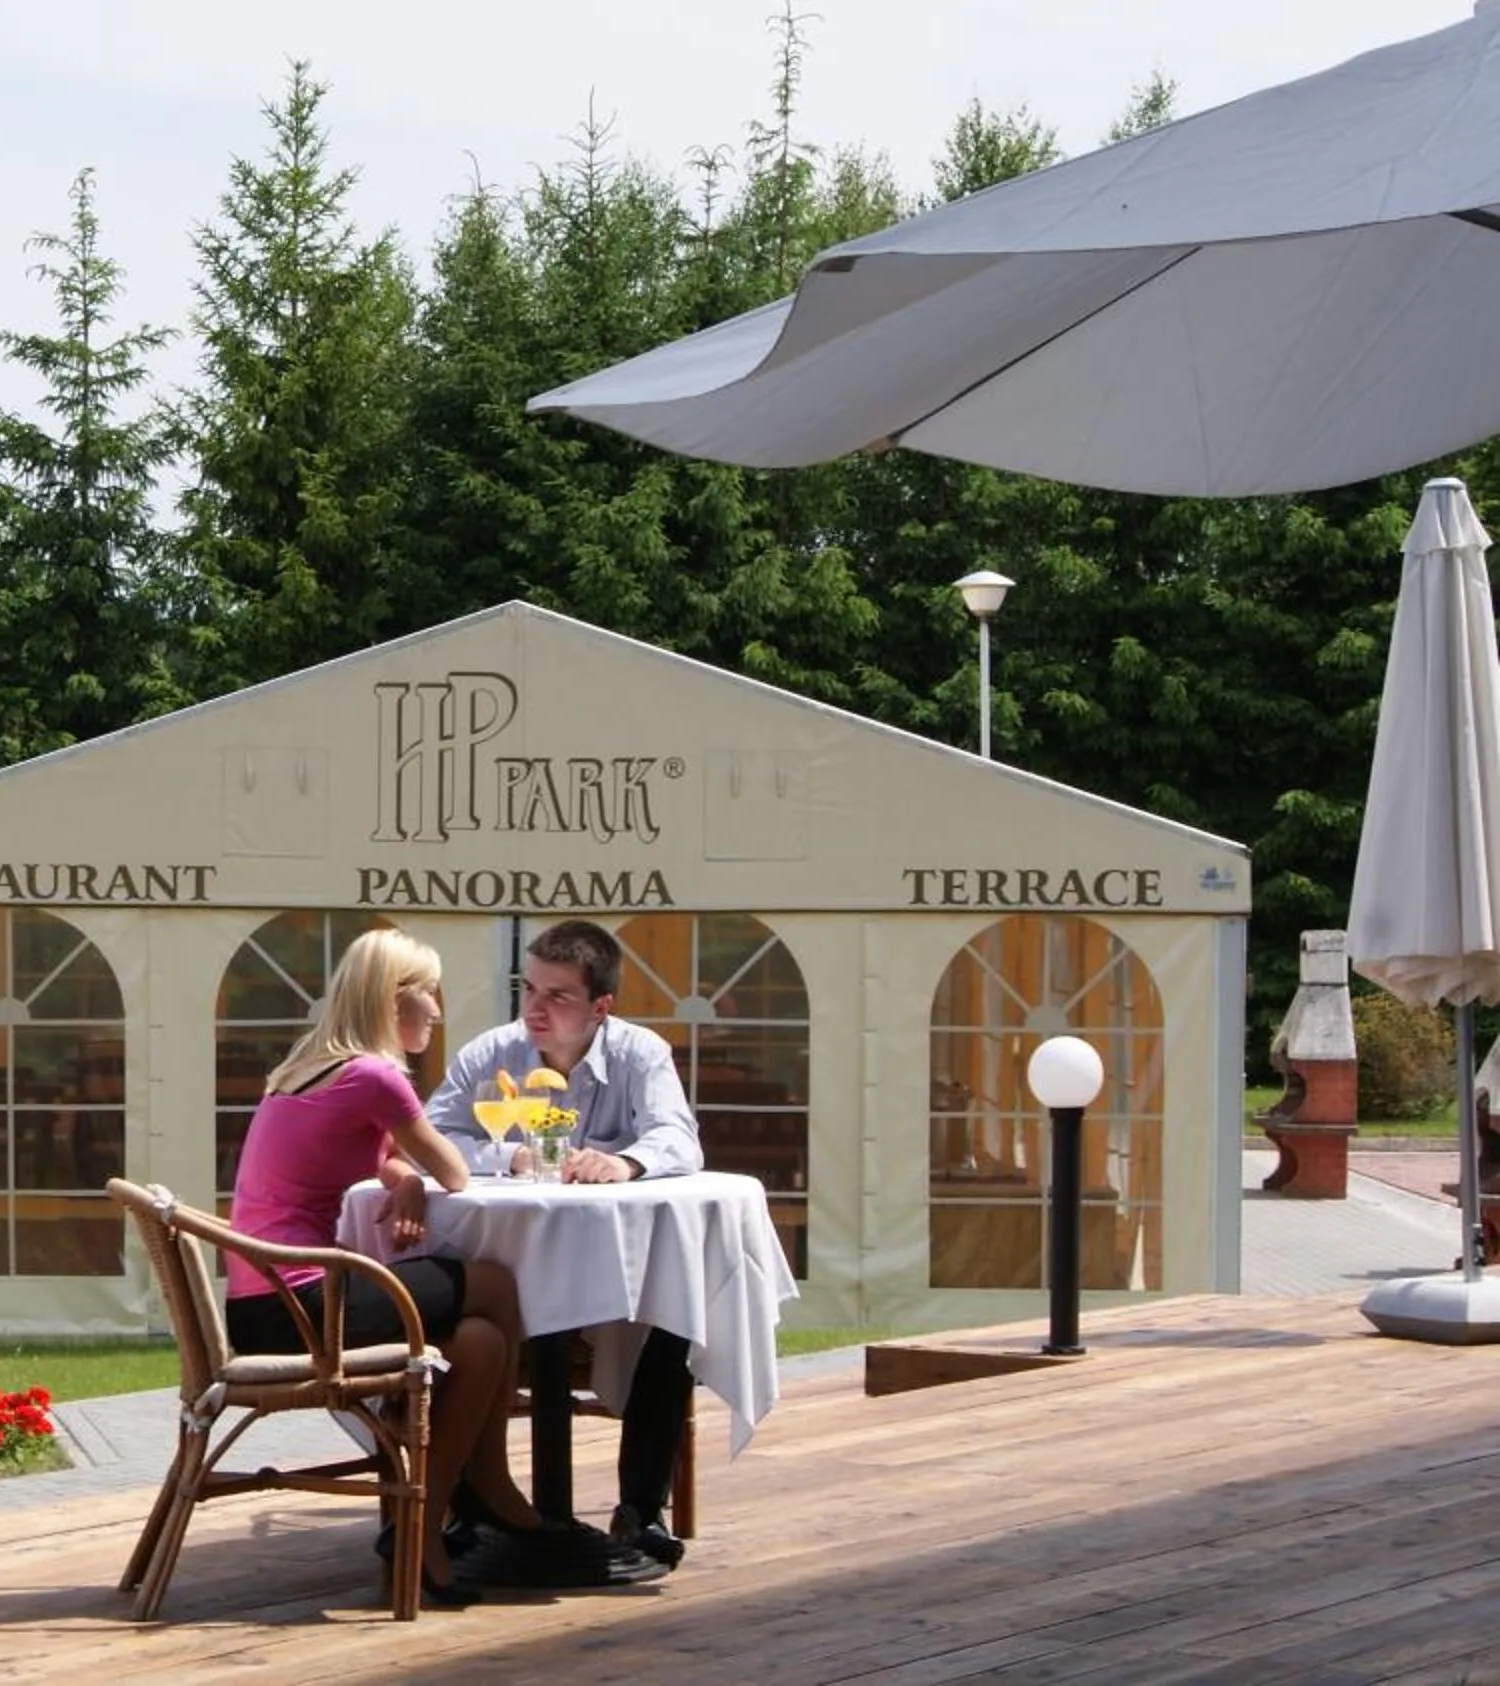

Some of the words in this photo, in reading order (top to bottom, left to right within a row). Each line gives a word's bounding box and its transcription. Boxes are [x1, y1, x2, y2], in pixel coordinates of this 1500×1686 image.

[370, 671, 518, 843] HP
[356, 867, 676, 907] PANORAMA
[902, 868, 1164, 907] TERRACE
